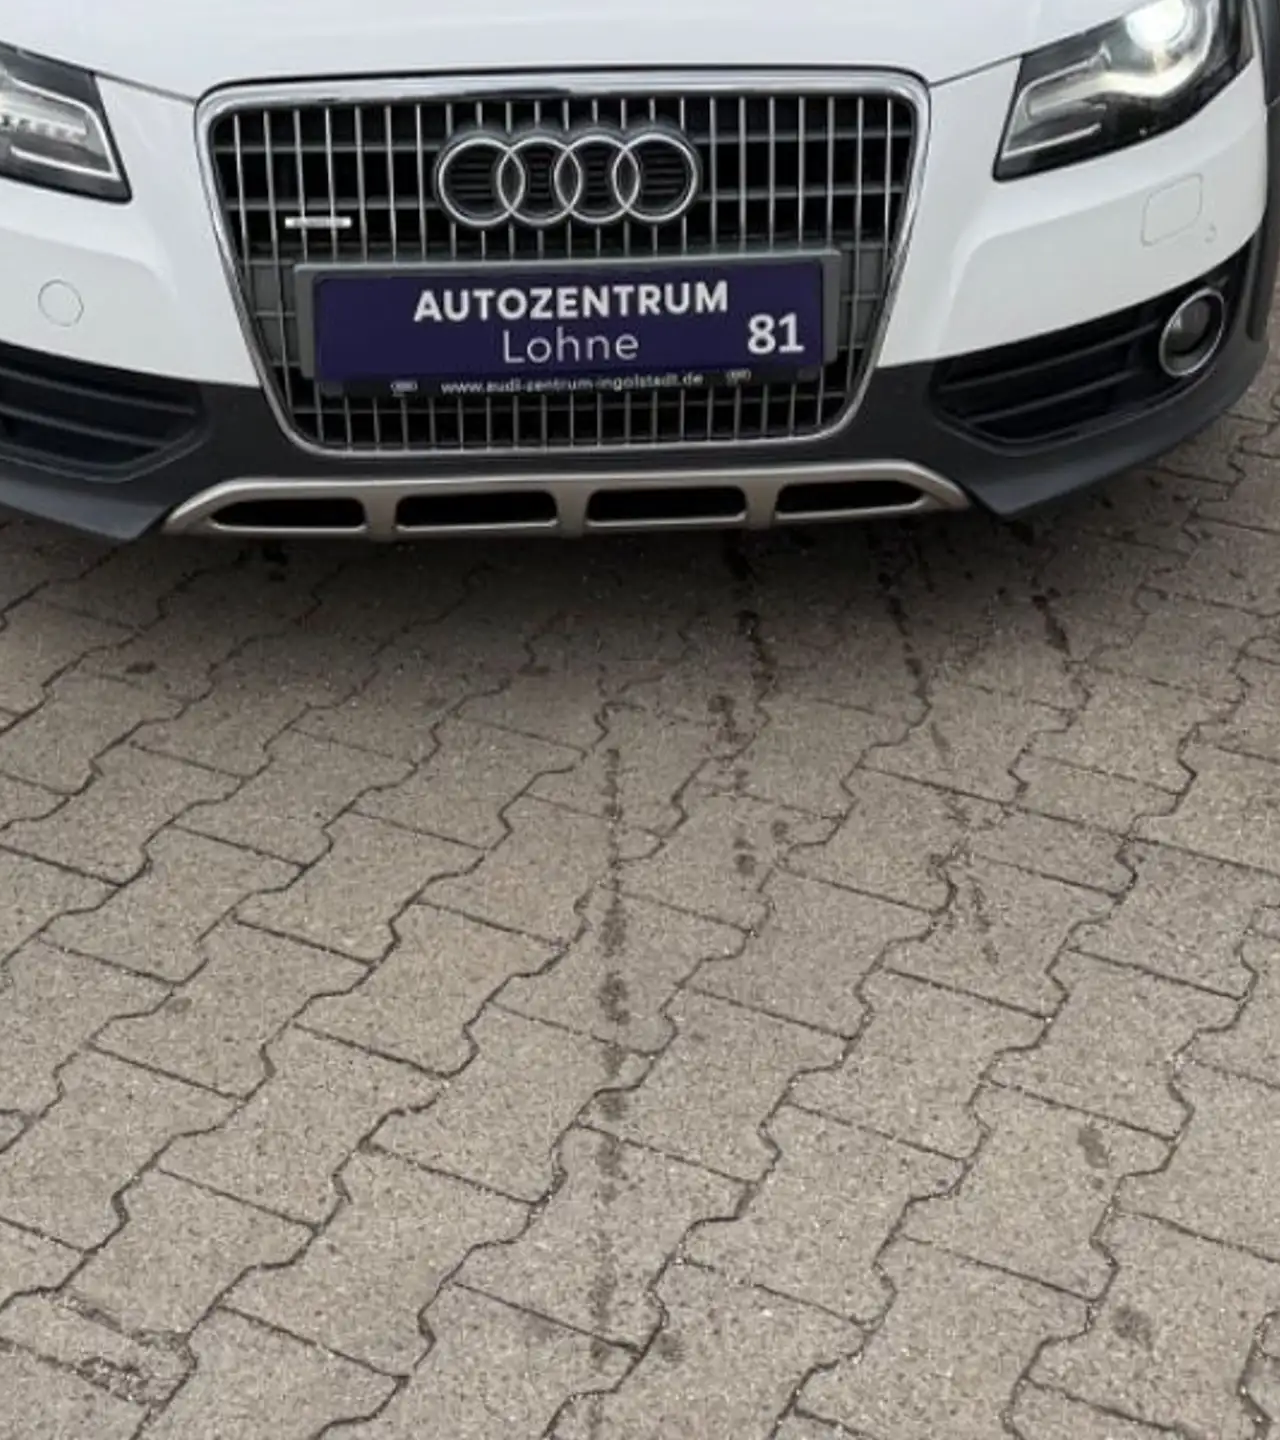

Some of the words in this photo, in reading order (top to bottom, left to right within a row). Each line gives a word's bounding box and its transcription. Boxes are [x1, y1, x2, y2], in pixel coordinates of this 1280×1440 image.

[412, 279, 730, 323] AUTOZENTRUM
[502, 324, 640, 364] Lohne
[746, 312, 806, 355] 81
